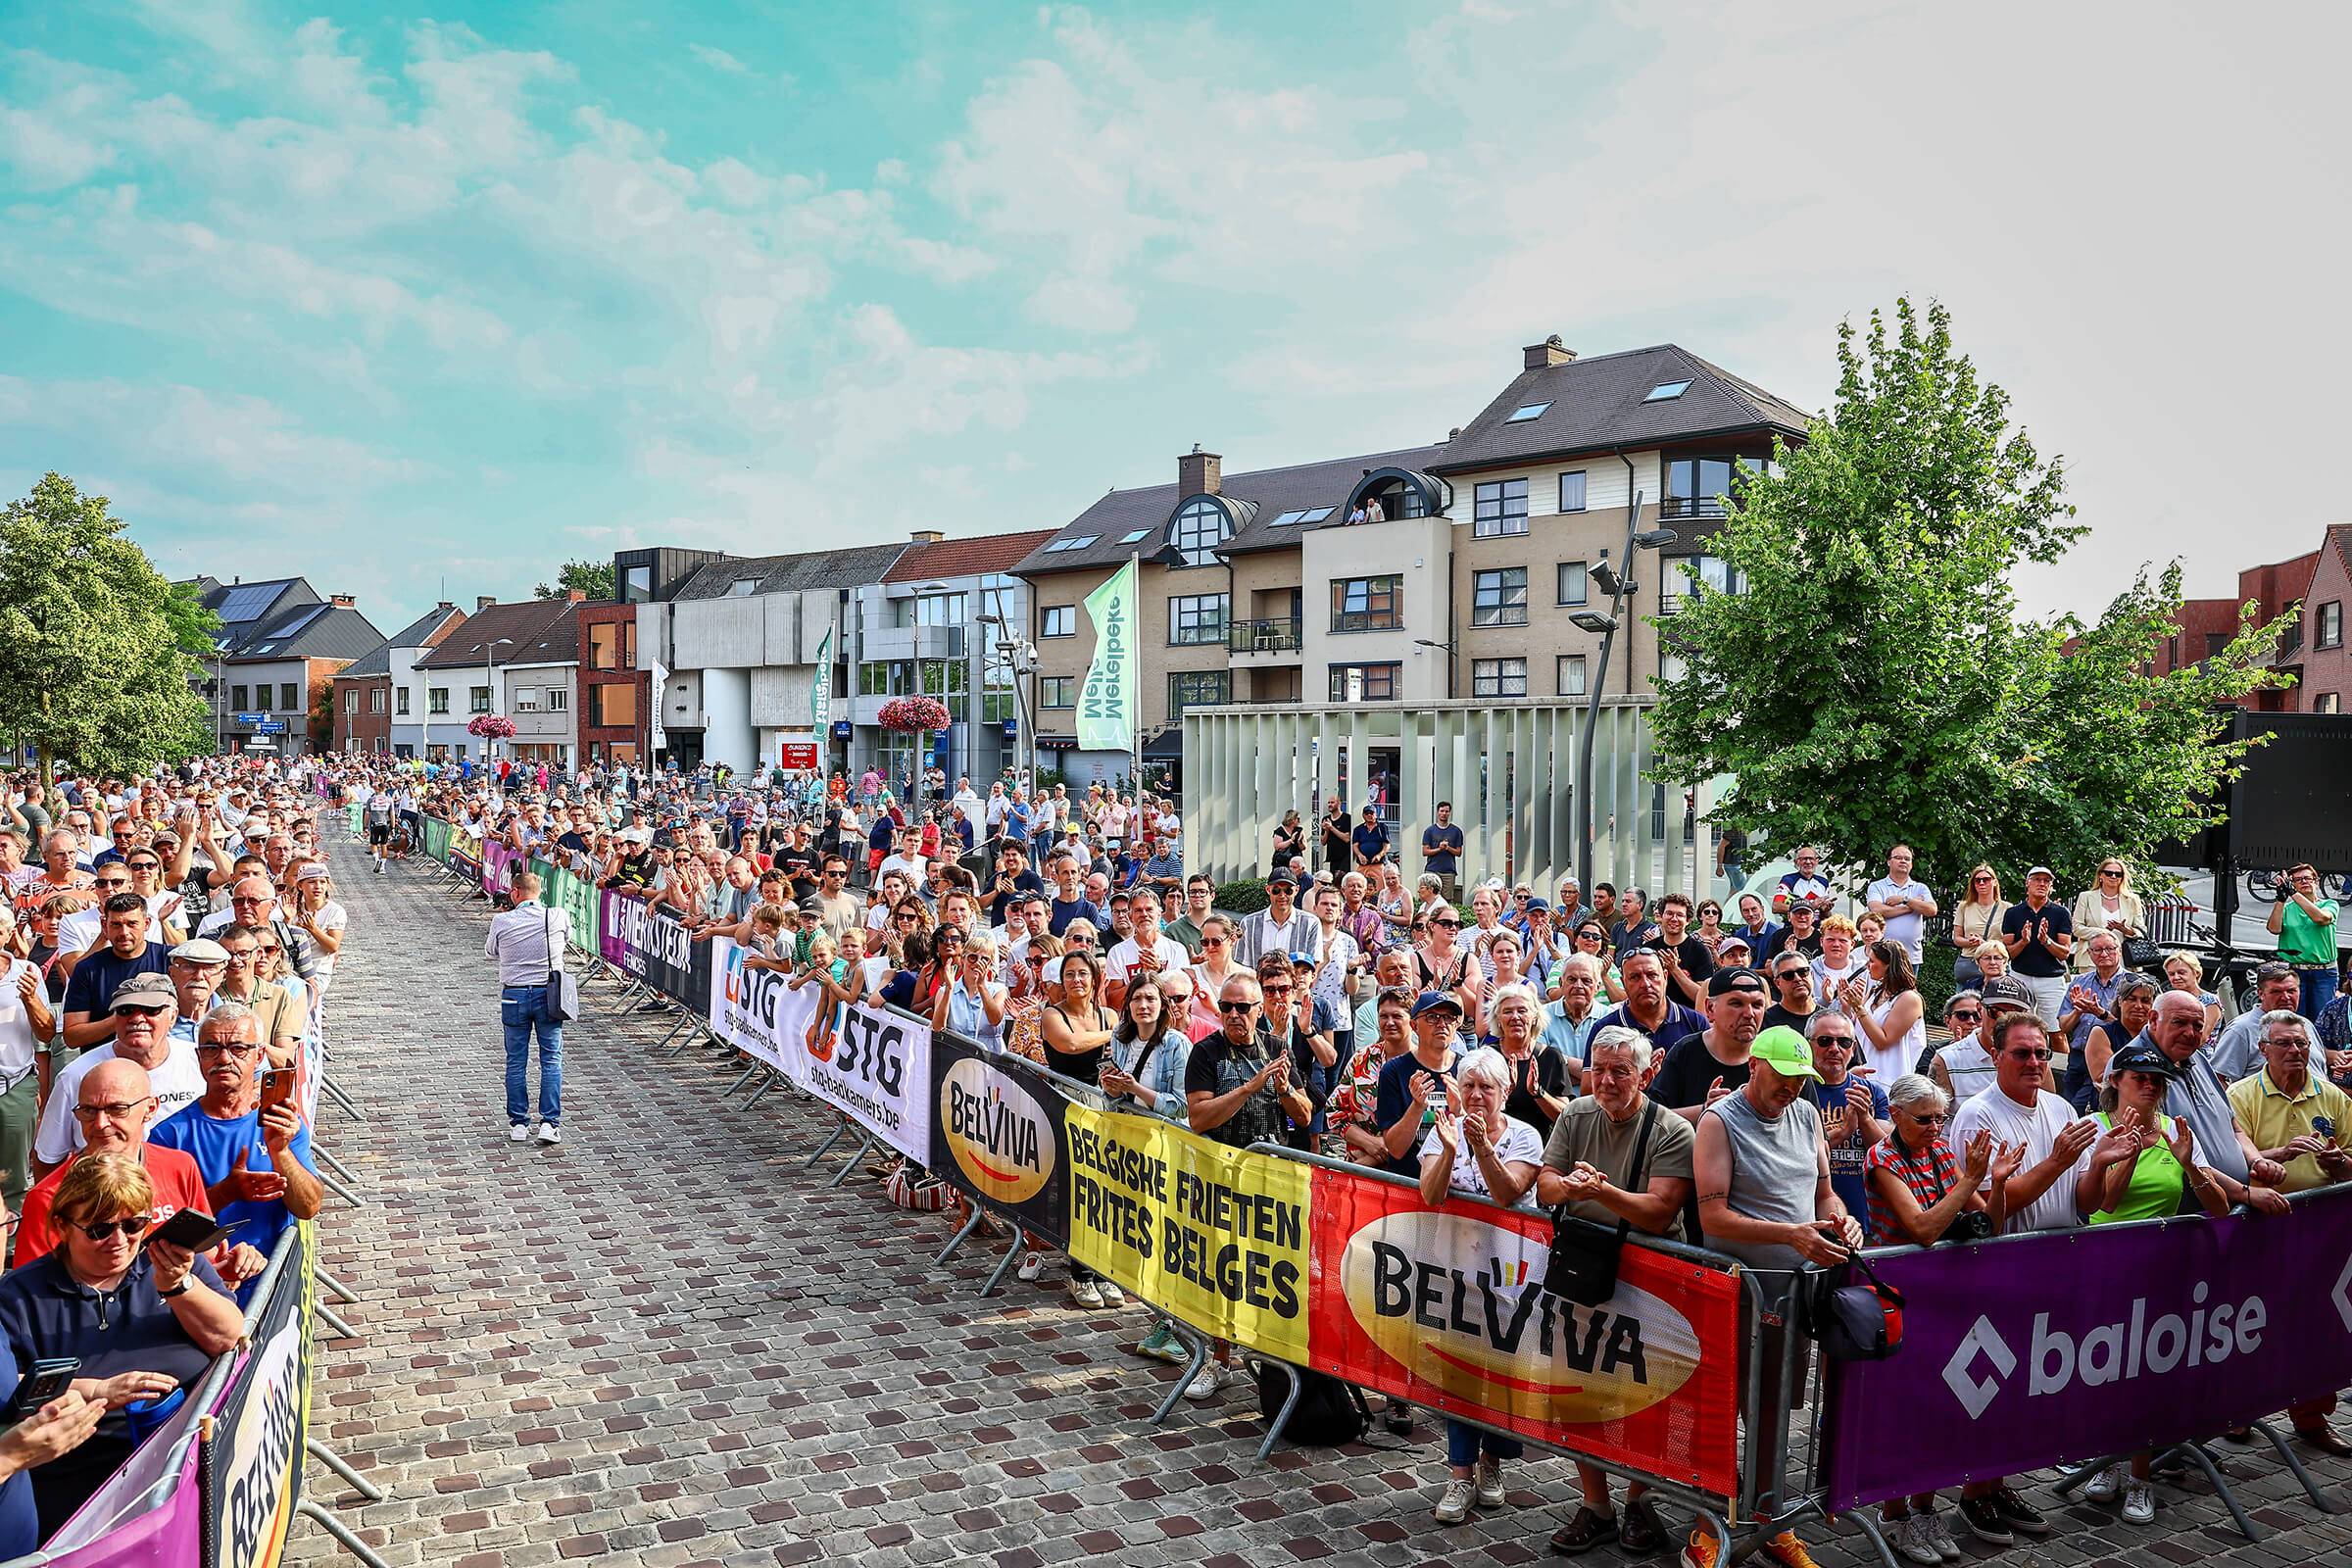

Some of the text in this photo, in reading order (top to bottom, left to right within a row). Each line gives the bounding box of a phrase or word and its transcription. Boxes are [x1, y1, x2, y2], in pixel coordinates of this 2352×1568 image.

[623, 951, 647, 976] FENCES
[740, 968, 785, 1029] STG
[810, 1065, 901, 1131] stg-badkamers.be
[836, 1007, 904, 1098] STG
[951, 1080, 1041, 1174] BELVIVA
[1068, 1123, 1301, 1250] BELGISHE FRIETEN
[1074, 1172, 1300, 1319] FRITES BELGES
[1371, 1241, 1648, 1385] BELVIVA
[2028, 1280, 2268, 1396] baloise
